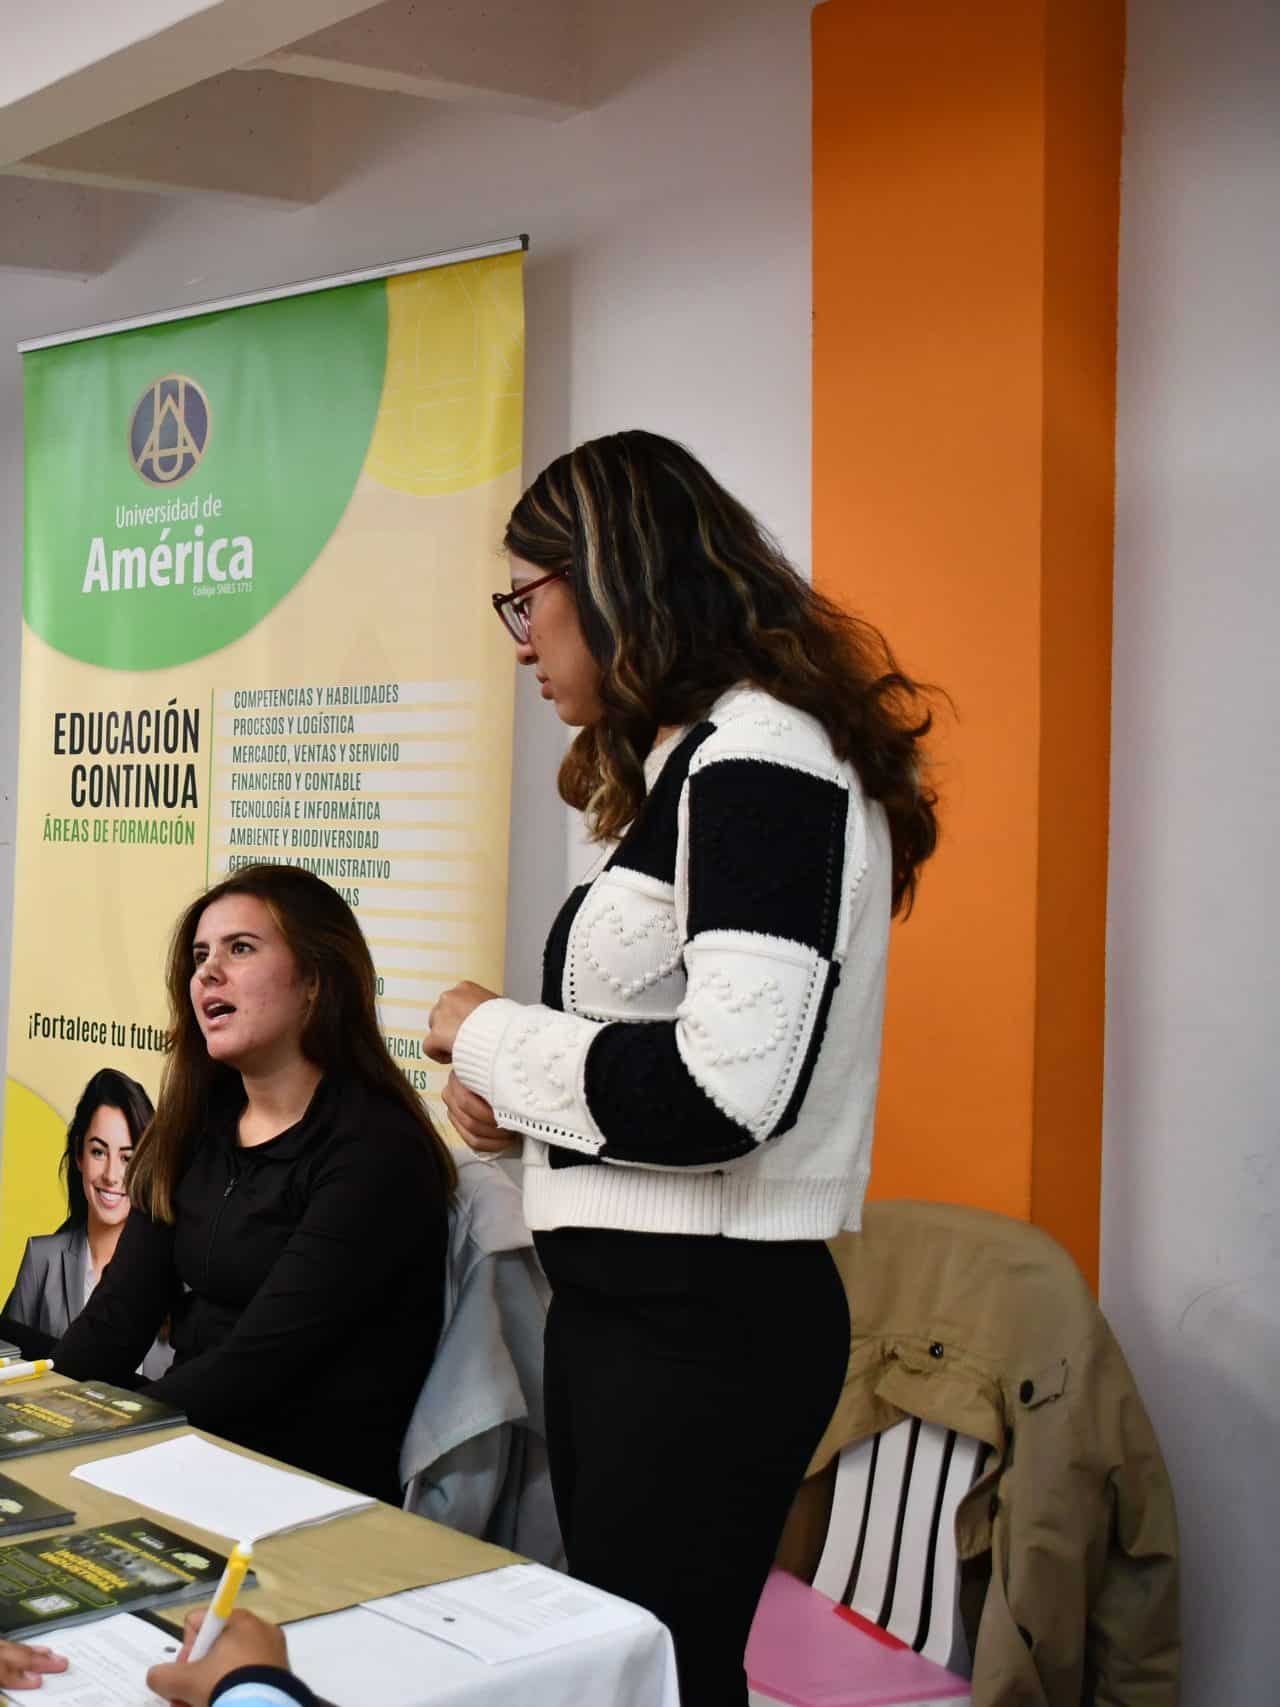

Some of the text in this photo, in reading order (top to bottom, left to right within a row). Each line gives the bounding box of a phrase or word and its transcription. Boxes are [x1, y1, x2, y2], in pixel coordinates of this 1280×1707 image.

[115, 492, 222, 528] Universidad de
[82, 524, 253, 593] América
[234, 684, 399, 709] COMPETENCIAS Y HABILIDADES
[54, 696, 200, 755] EDUCACIÓN
[234, 712, 355, 736] PROCESOS Y LOGÍSTICA
[232, 742, 400, 765] MERCADEO, VENTAS Y SERVICIO
[71, 763, 199, 808] CONTINUA
[232, 772, 361, 791] FINANCIERO Y CONTABLE
[231, 796, 381, 820] TECNOLOGÍA E INFORMÁTICA
[43, 812, 195, 845] ÁREAS DE FORMACIÓN
[230, 828, 379, 849] AMBIENTE Y BIODIVERSIDAD
[296, 857, 391, 879] ADMINISTRATIVO
[28, 1013, 107, 1045] ¡Fortalece
[111, 1021, 126, 1047] tu
[384, 1036, 422, 1060] FICIAL
